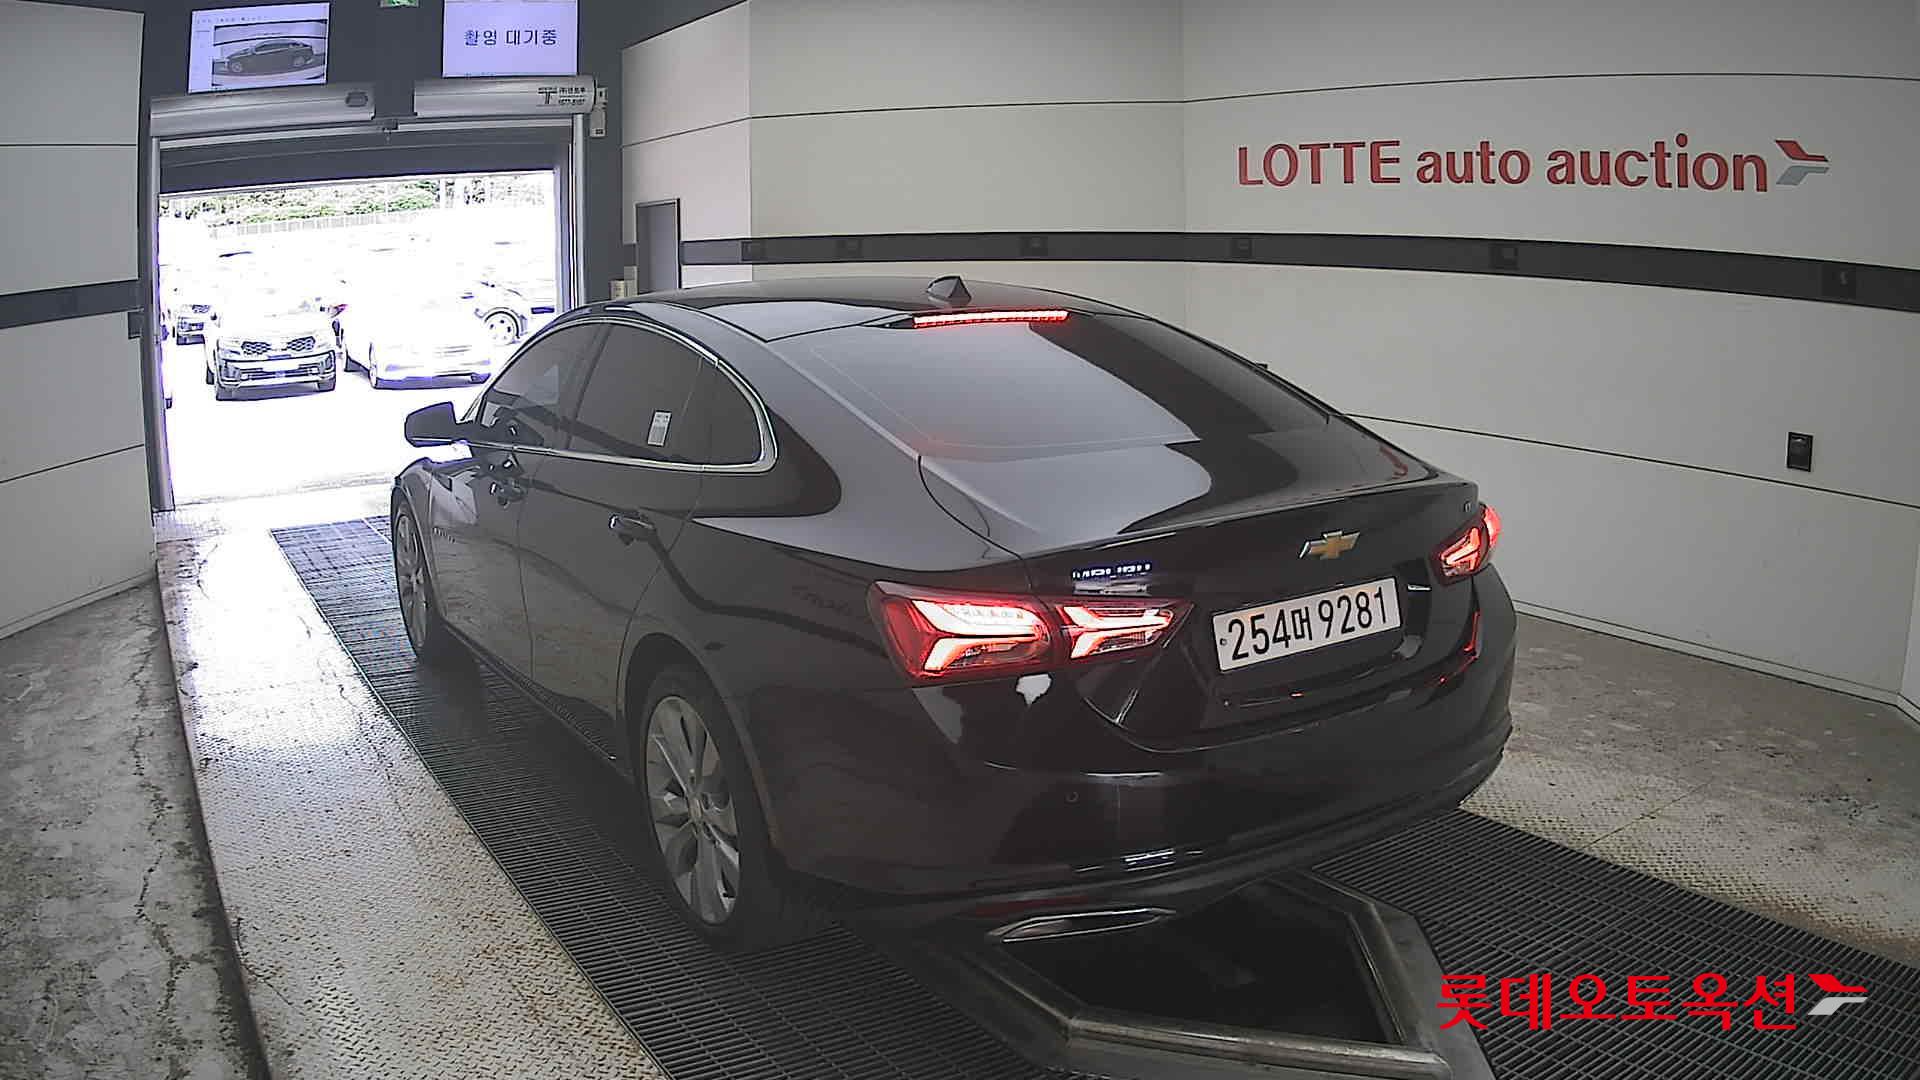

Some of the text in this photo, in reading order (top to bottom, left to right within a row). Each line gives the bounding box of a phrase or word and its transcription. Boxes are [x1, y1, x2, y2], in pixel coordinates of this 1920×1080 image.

[505, 28, 558, 46] 대기중
[1237, 133, 1769, 192] LOTTE auto auction
[1228, 586, 1387, 661] 254머 9281
